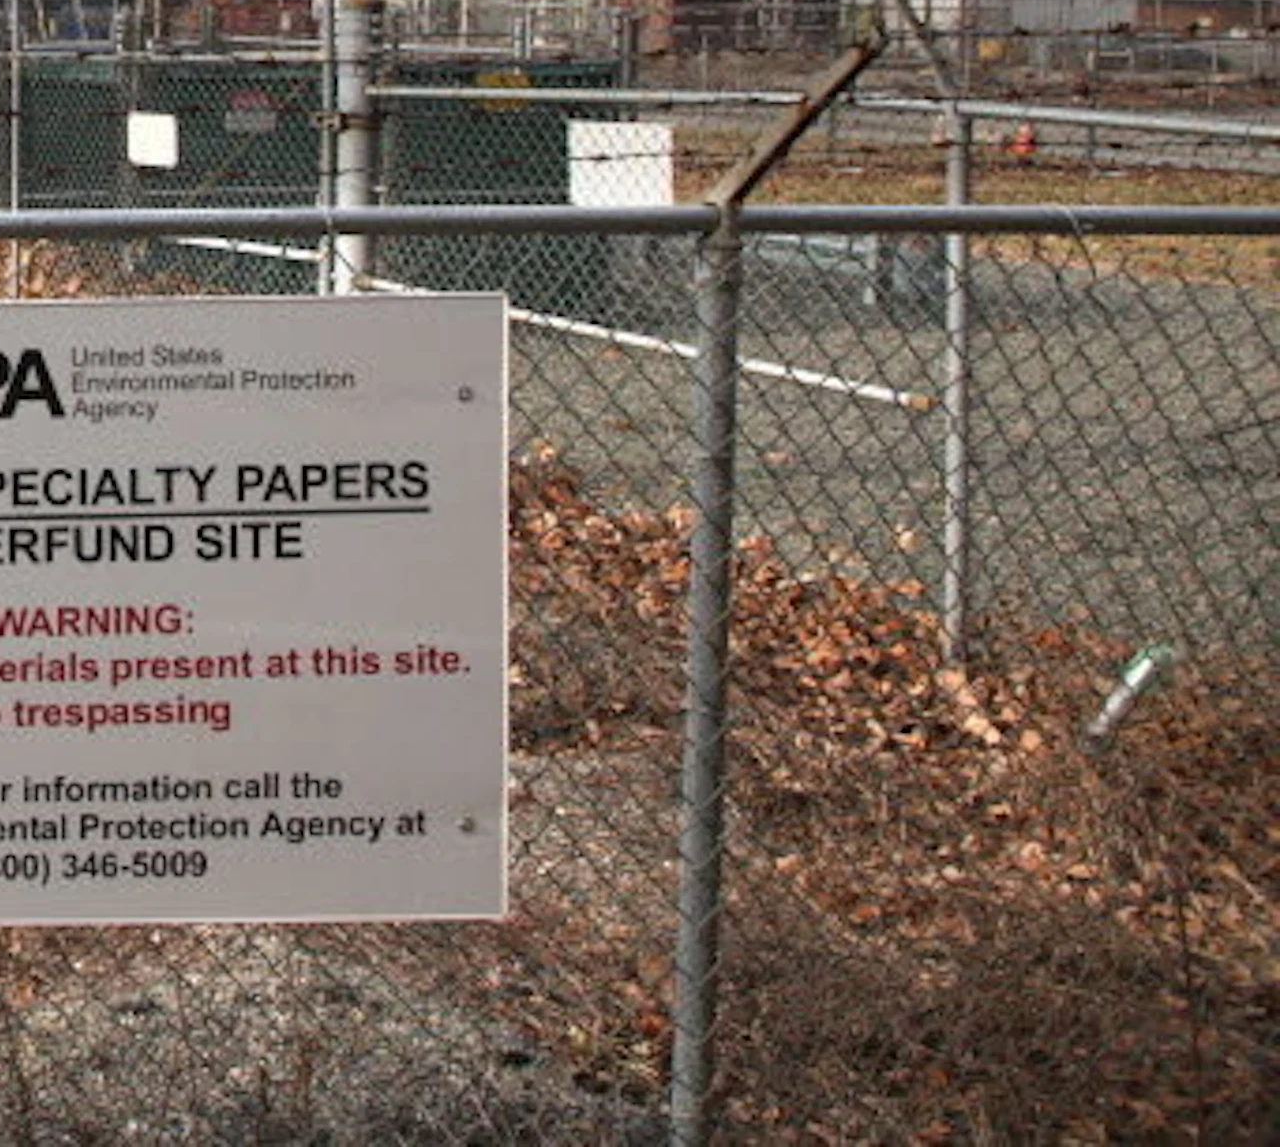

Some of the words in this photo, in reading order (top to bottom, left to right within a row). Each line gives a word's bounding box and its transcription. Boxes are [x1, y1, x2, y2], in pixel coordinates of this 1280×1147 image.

[72, 347, 144, 367] United
[152, 345, 222, 367] States
[72, 371, 234, 393] Environmental
[241, 370, 356, 390] Protection
[73, 398, 158, 423] Agency
[236, 460, 429, 502] PAPERS
[195, 521, 304, 562] SITE
[111, 649, 253, 689] present
[265, 648, 301, 678] at
[311, 645, 381, 677] this
[394, 644, 470, 675] site.
[12, 694, 231, 734] trespassing
[23, 775, 213, 803] information
[223, 772, 280, 800] call
[290, 772, 343, 799] the
[80, 812, 249, 840] Protection
[260, 811, 386, 844] Agency
[395, 810, 427, 836] at
[62, 850, 208, 880] 346-5009
